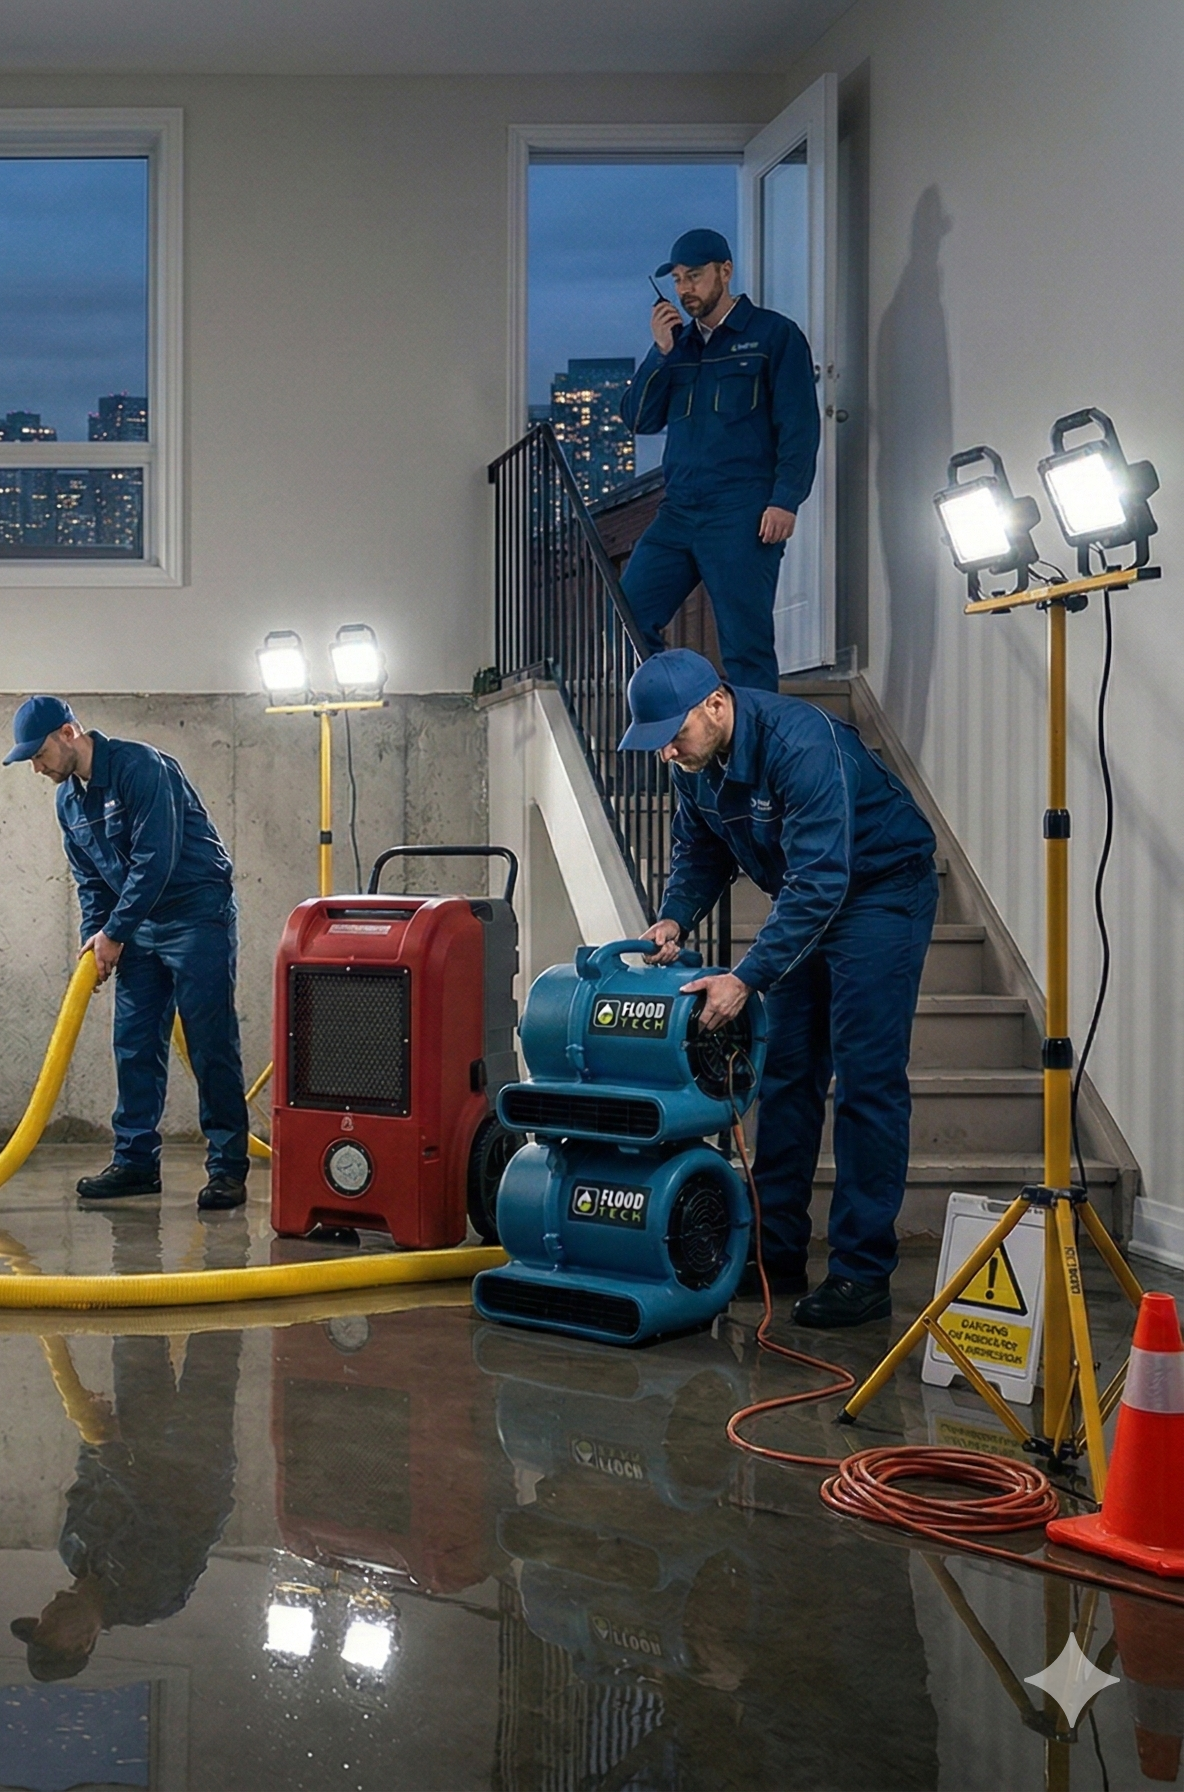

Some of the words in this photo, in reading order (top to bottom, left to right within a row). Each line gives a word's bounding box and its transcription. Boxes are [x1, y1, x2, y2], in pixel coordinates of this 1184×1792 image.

[621, 1002, 666, 1019] FLOOD
[620, 1017, 665, 1031] TECH
[600, 1189, 644, 1210] FLOOD
